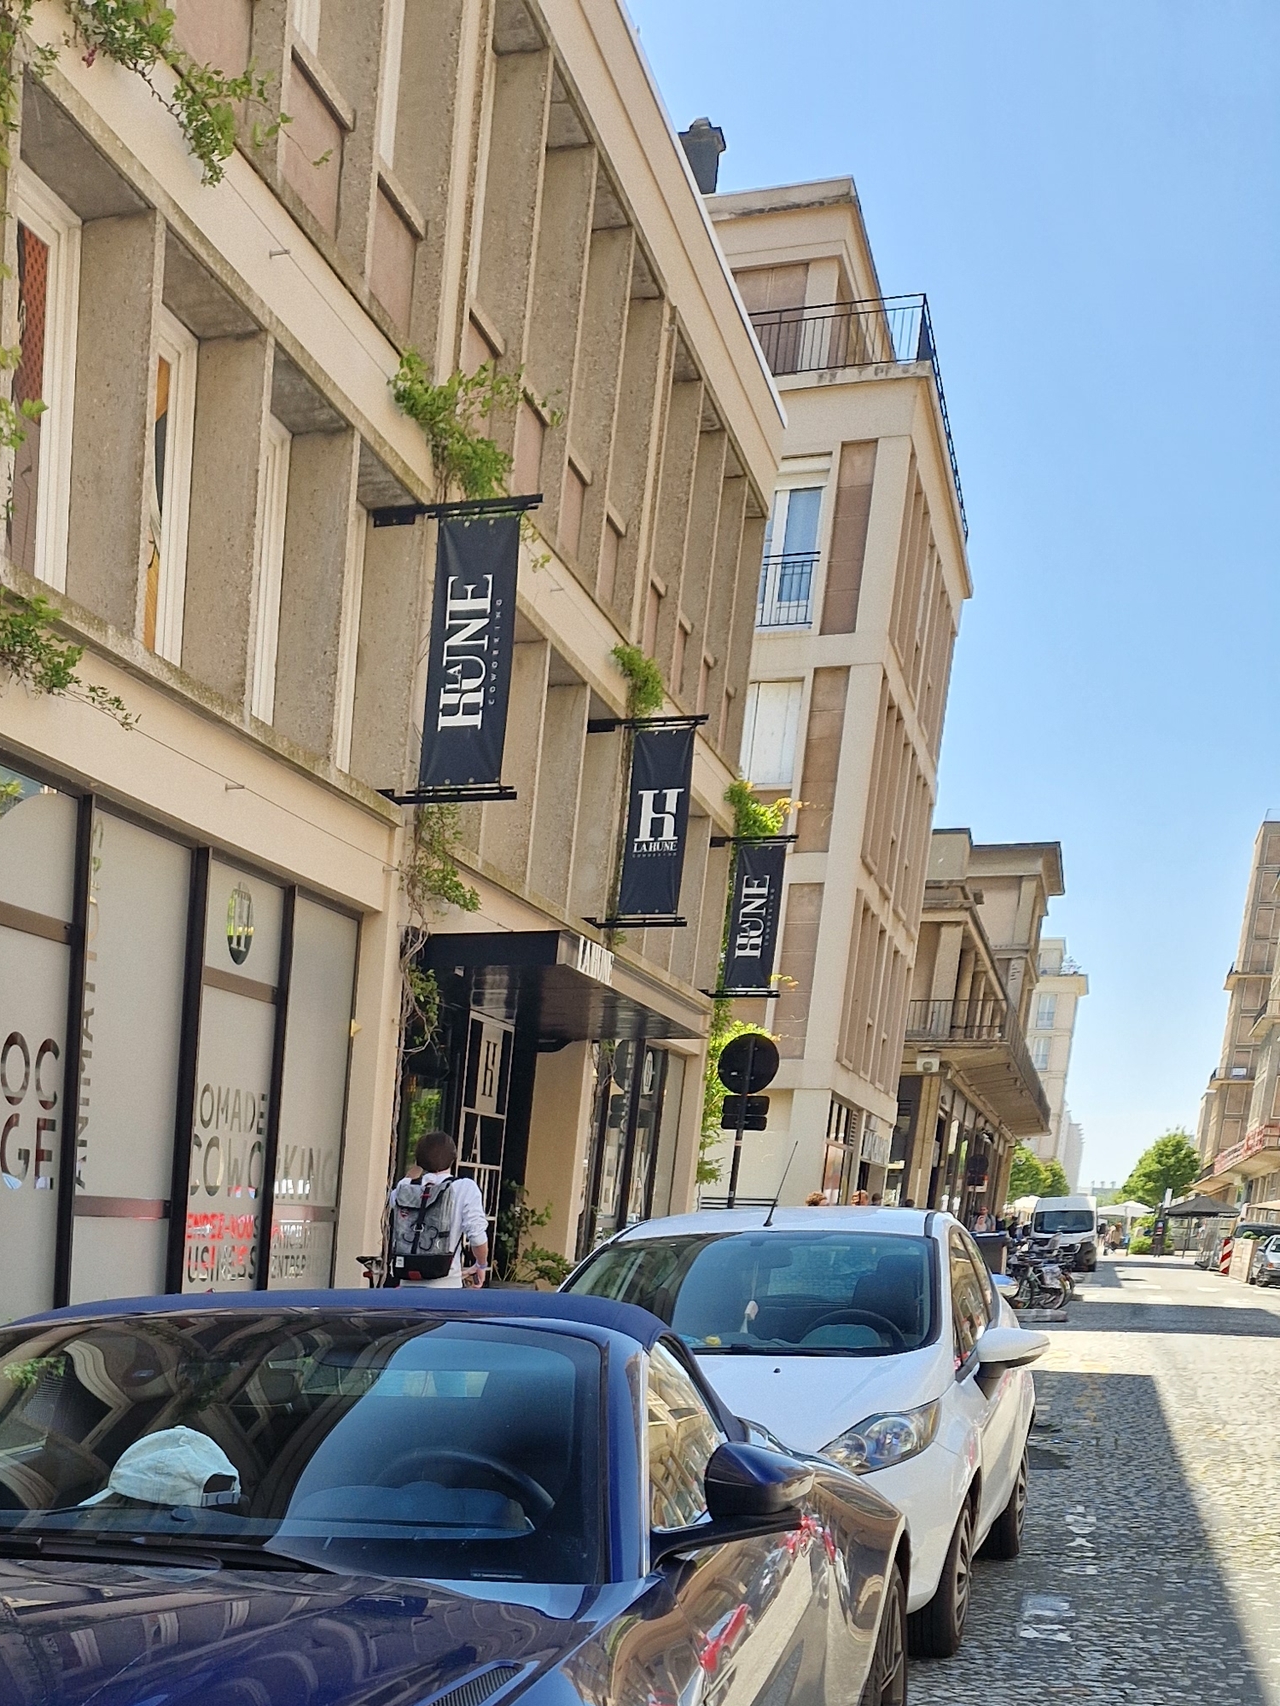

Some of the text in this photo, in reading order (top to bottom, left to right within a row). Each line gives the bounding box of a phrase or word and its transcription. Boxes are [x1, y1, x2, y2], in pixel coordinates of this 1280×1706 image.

[437, 574, 493, 732] HUNE
[734, 875, 771, 959] HUNE
[194, 1082, 268, 1135] OMADE
